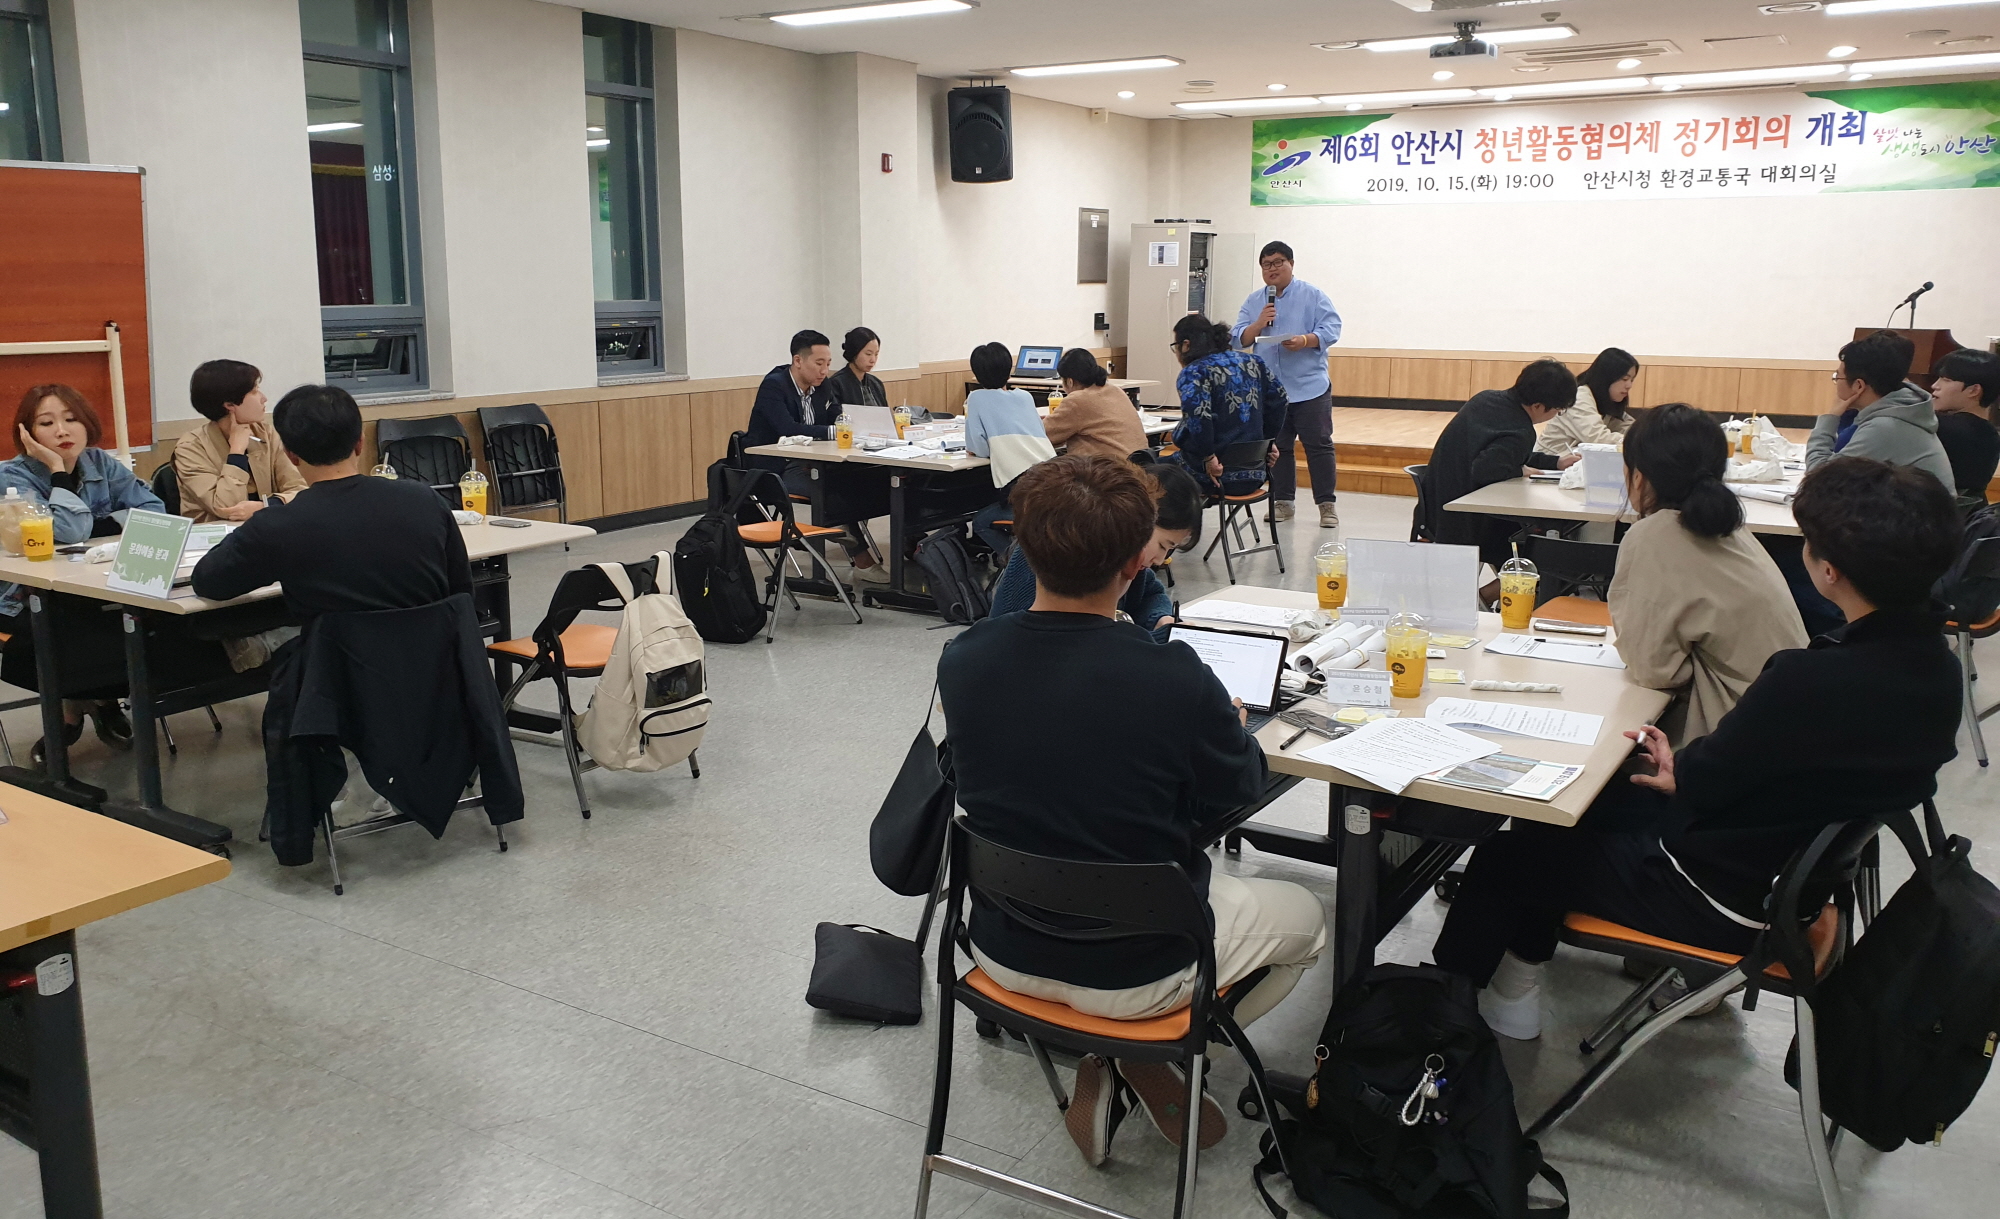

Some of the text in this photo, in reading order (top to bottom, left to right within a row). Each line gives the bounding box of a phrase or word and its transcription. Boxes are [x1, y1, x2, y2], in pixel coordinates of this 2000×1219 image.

[1319, 110, 1868, 166] 제6회 안산시 청년활동협의체 정기회의 개최
[1270, 180, 1302, 189] 안산시
[1367, 163, 1837, 193] 2019. 10. 15.(화) 19:00 안산시청 환경교통국 대회의실
[128, 542, 170, 562] 문화예술 분과
